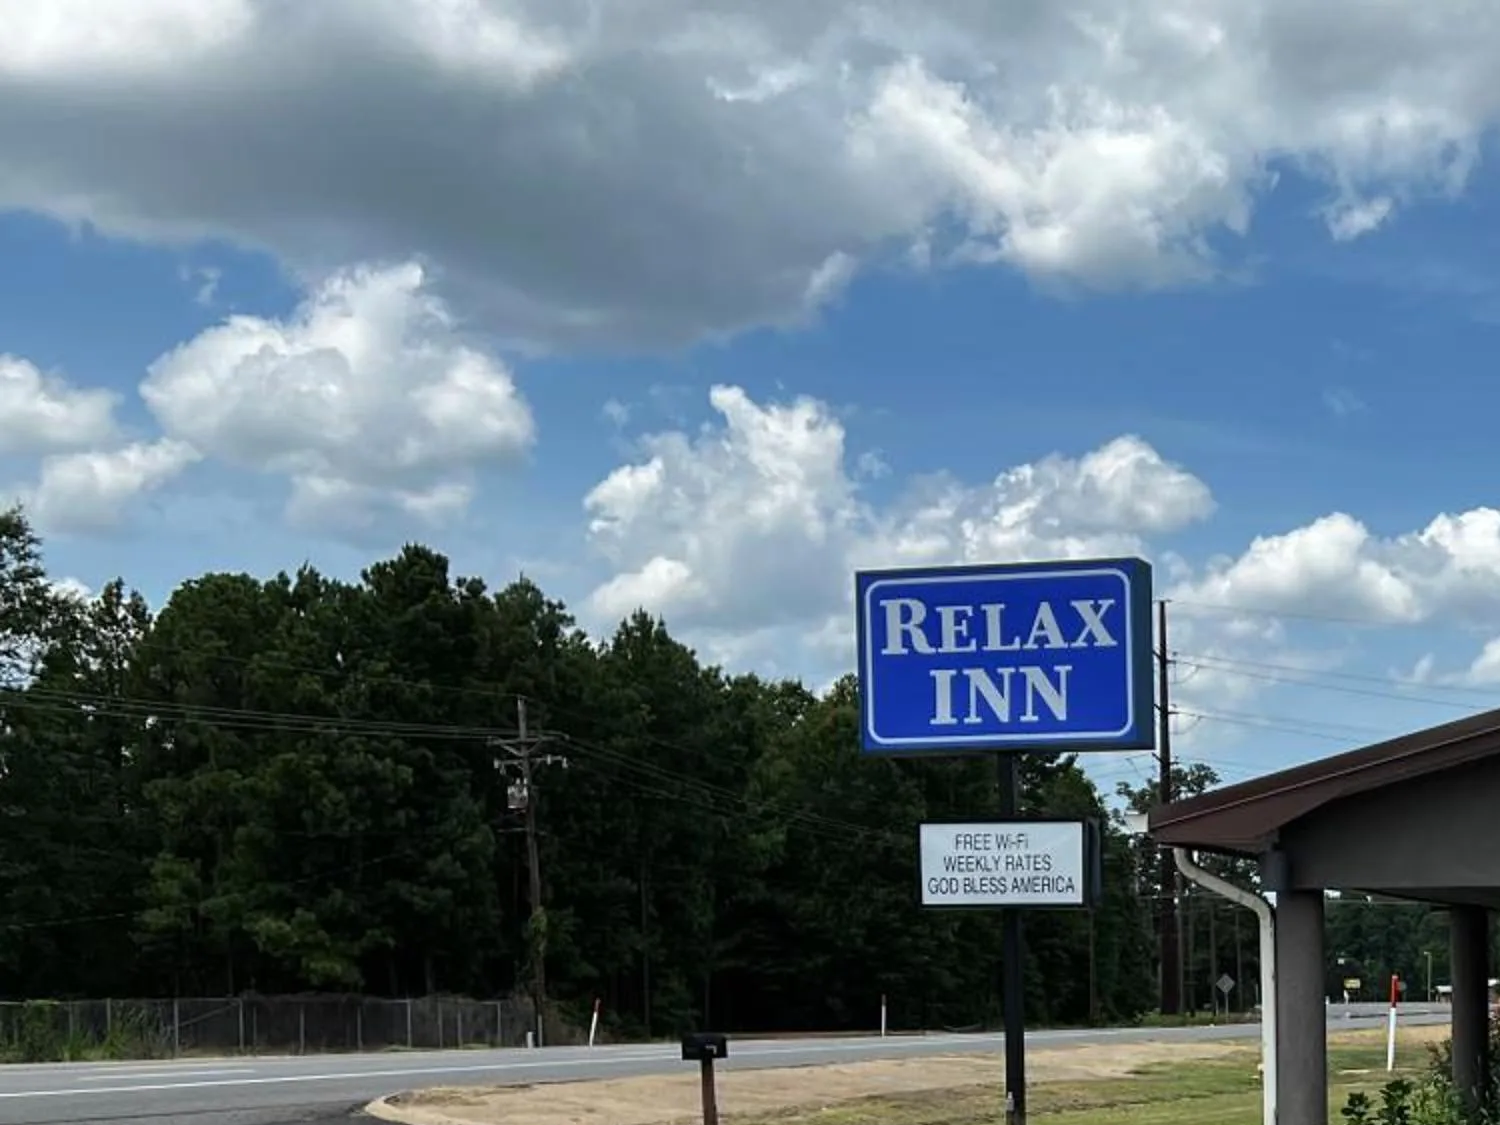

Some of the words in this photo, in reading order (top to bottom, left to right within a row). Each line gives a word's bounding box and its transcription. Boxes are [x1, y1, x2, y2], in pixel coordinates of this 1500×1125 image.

[880, 598, 1117, 655] RELAX
[929, 665, 1072, 725] INN
[955, 833, 992, 851] FREE
[943, 855, 1001, 873] WEEKLY
[1005, 854, 1053, 872] RATES
[927, 877, 959, 895] GOD
[963, 876, 1007, 894] BLESS
[1011, 874, 1075, 893] AMERICA
